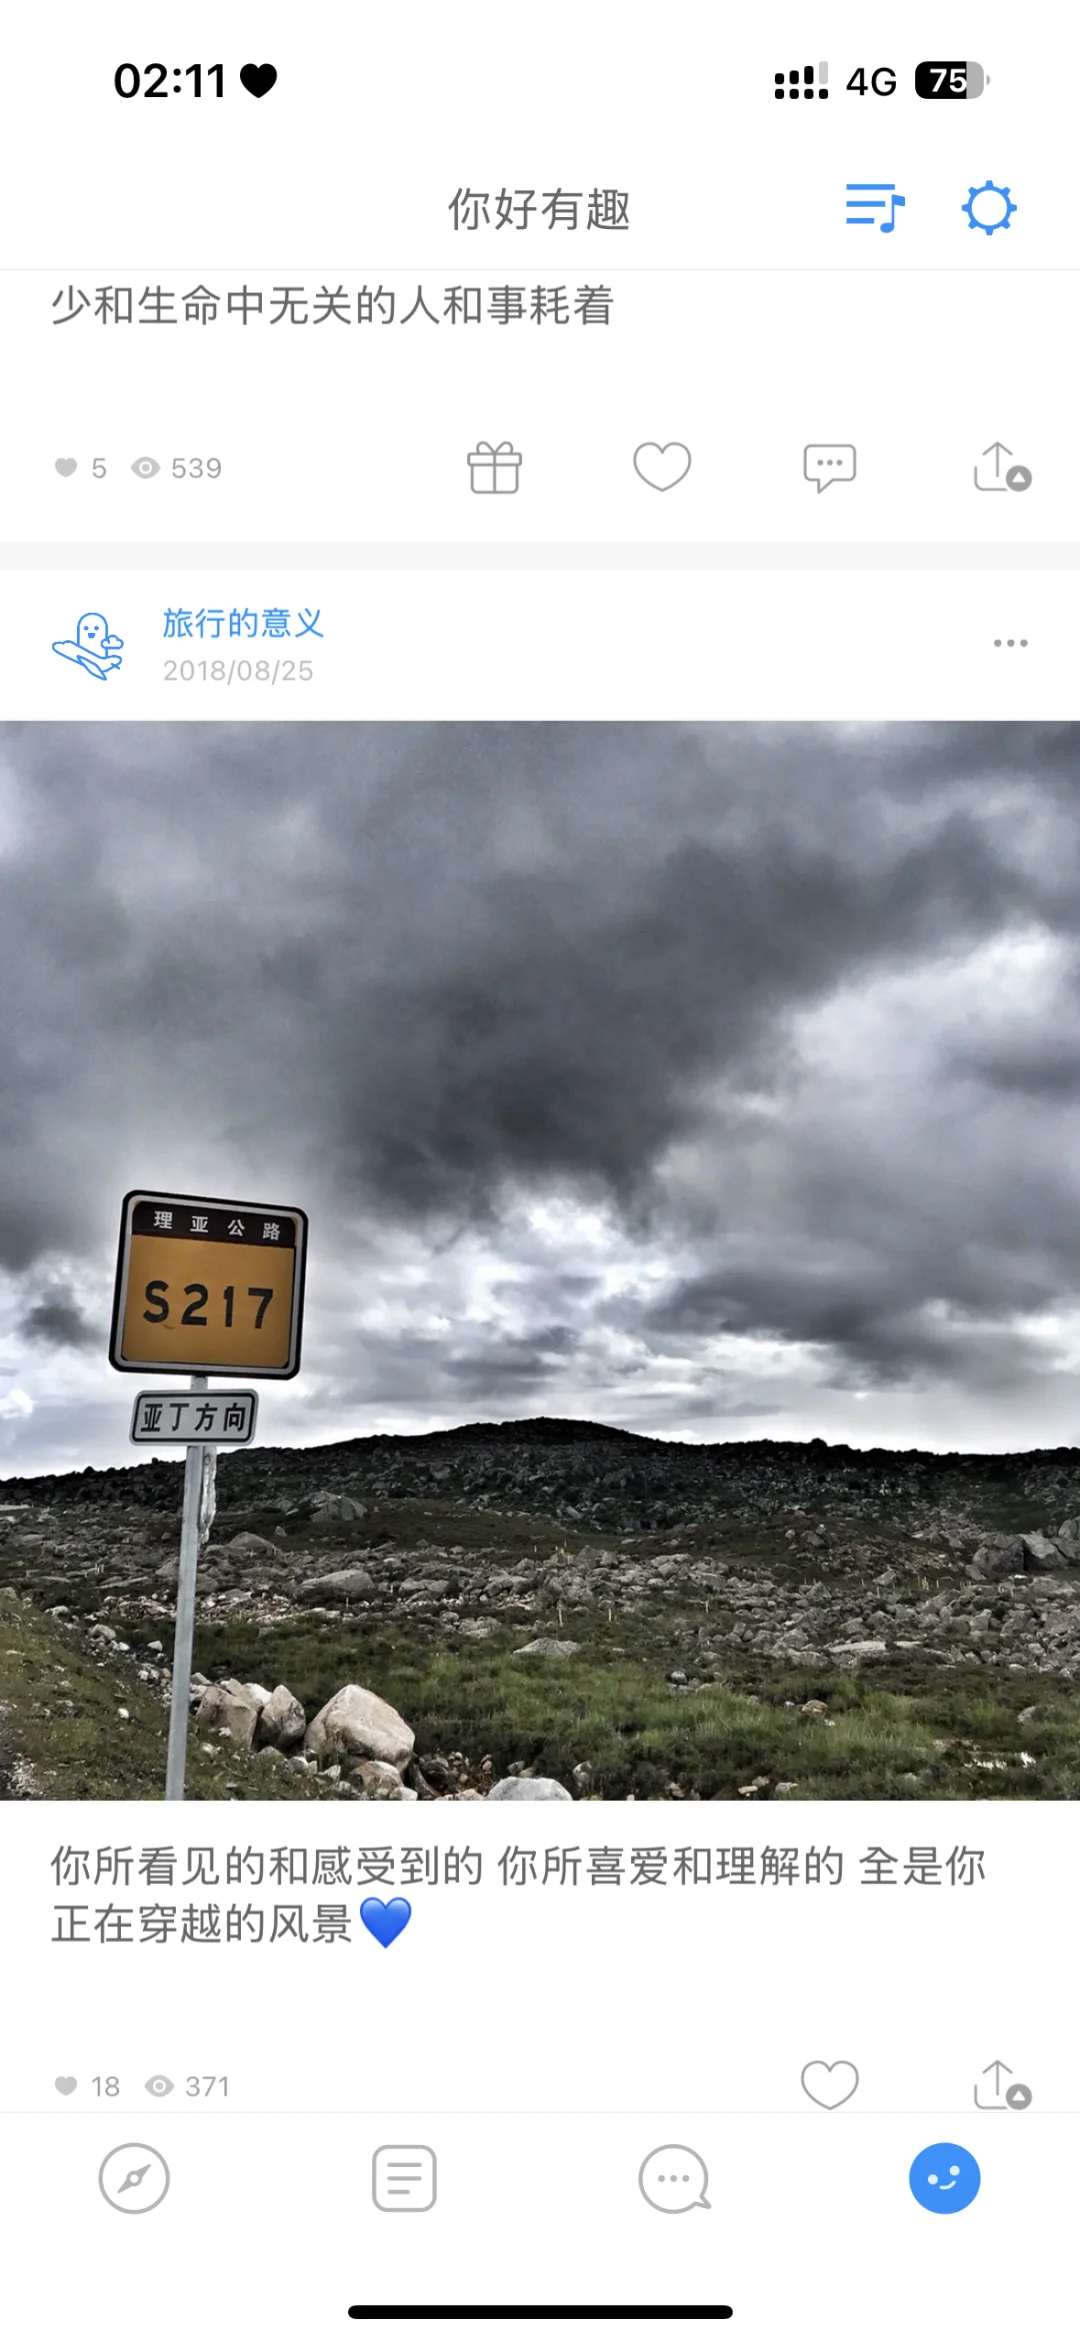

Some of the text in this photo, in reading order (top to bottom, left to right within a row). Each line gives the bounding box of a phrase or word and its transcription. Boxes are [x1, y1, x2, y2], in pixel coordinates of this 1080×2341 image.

[114, 63, 224, 98] 02:11
[846, 67, 897, 97] 4G
[930, 68, 968, 93] 75
[448, 188, 629, 230] 你好有趣
[51, 284, 614, 325] 少和生命中无关的人和事耗着
[92, 458, 107, 479] 5
[172, 458, 222, 479] 539
[163, 607, 325, 640] 旅行的意义
[163, 659, 314, 685] 2018/08/25
[153, 1210, 281, 1241] 理亚公路
[143, 1280, 273, 1329] S217
[140, 1402, 247, 1432] 亚丁方向
[51, 1845, 986, 1886] 你所看见的和感受到的 你所喜爱和理解的 全是你
[51, 1903, 352, 1944] 正在穿越的风景
[91, 2076, 120, 2098] 18
[185, 2076, 229, 2098] 371
